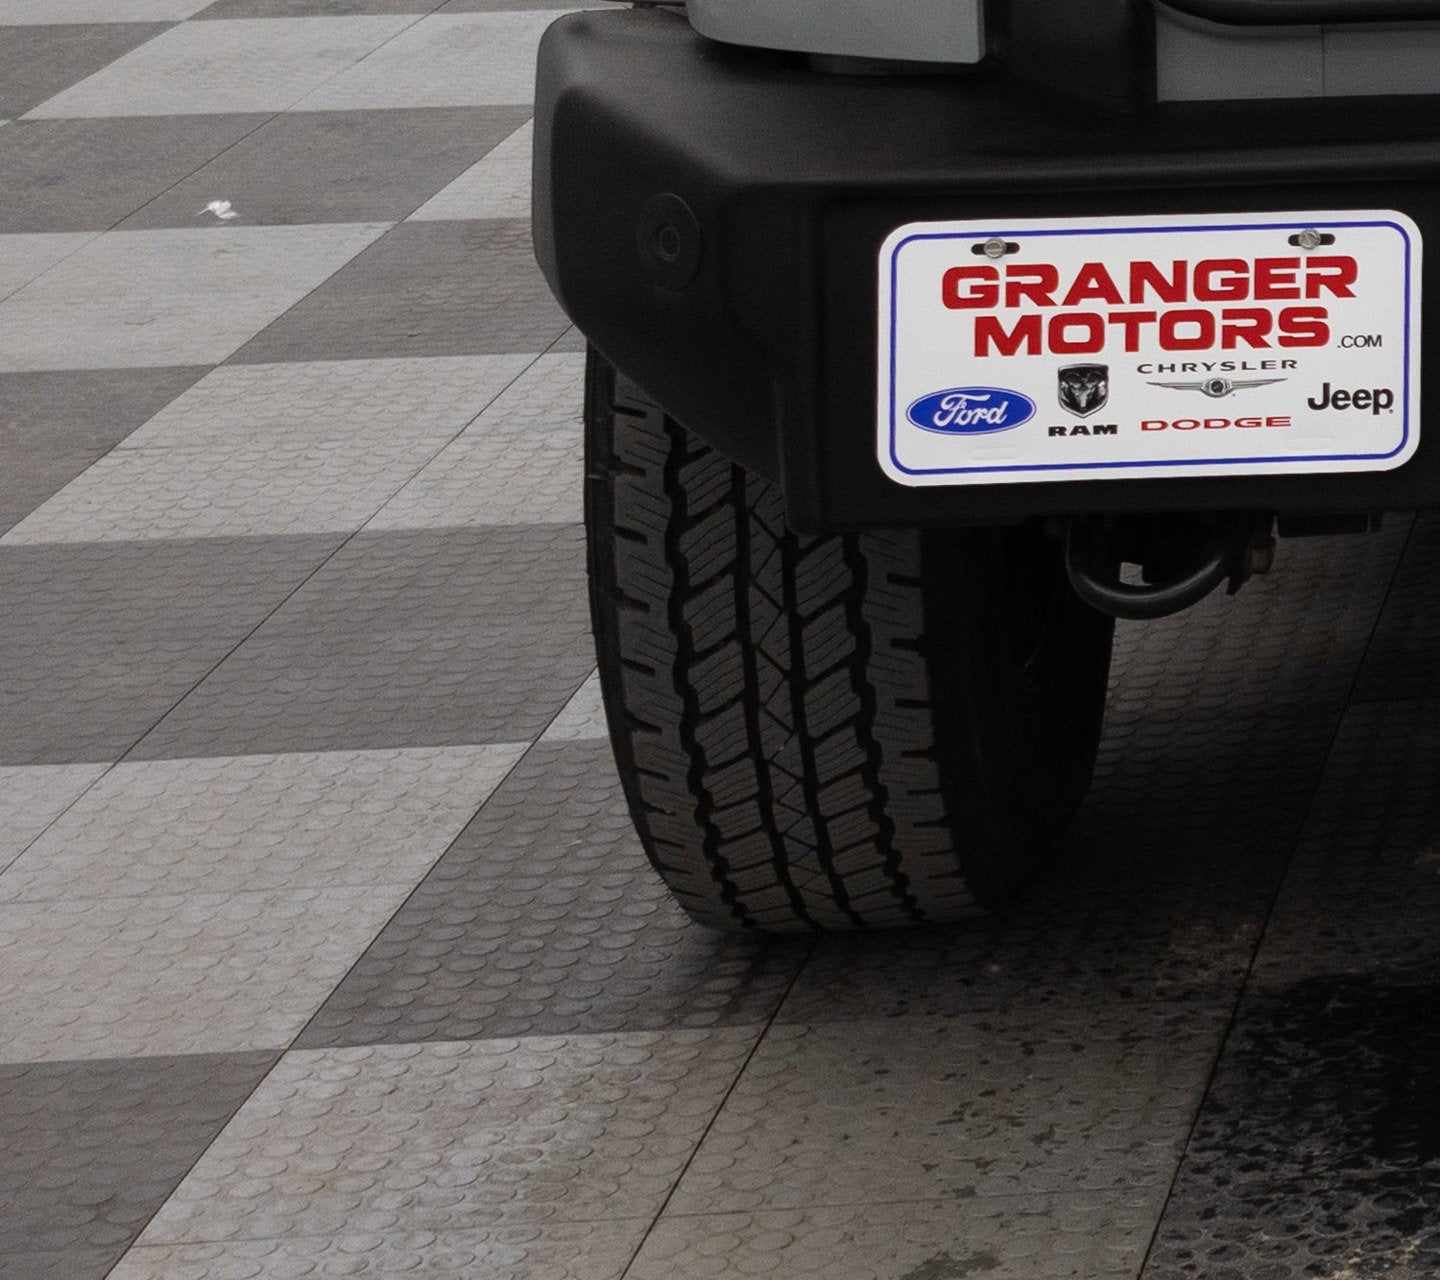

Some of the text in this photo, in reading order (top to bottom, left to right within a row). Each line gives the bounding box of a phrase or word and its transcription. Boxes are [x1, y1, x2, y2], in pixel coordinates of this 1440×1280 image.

[942, 255, 1358, 310] GRANGER
[973, 306, 1383, 357] MOTORS .COM
[1137, 359, 1298, 374] CHRYSLER
[932, 393, 1009, 428] Ford
[1306, 382, 1394, 415] Jeep
[1047, 422, 1119, 437] RAM
[1140, 416, 1292, 431] DODGE
